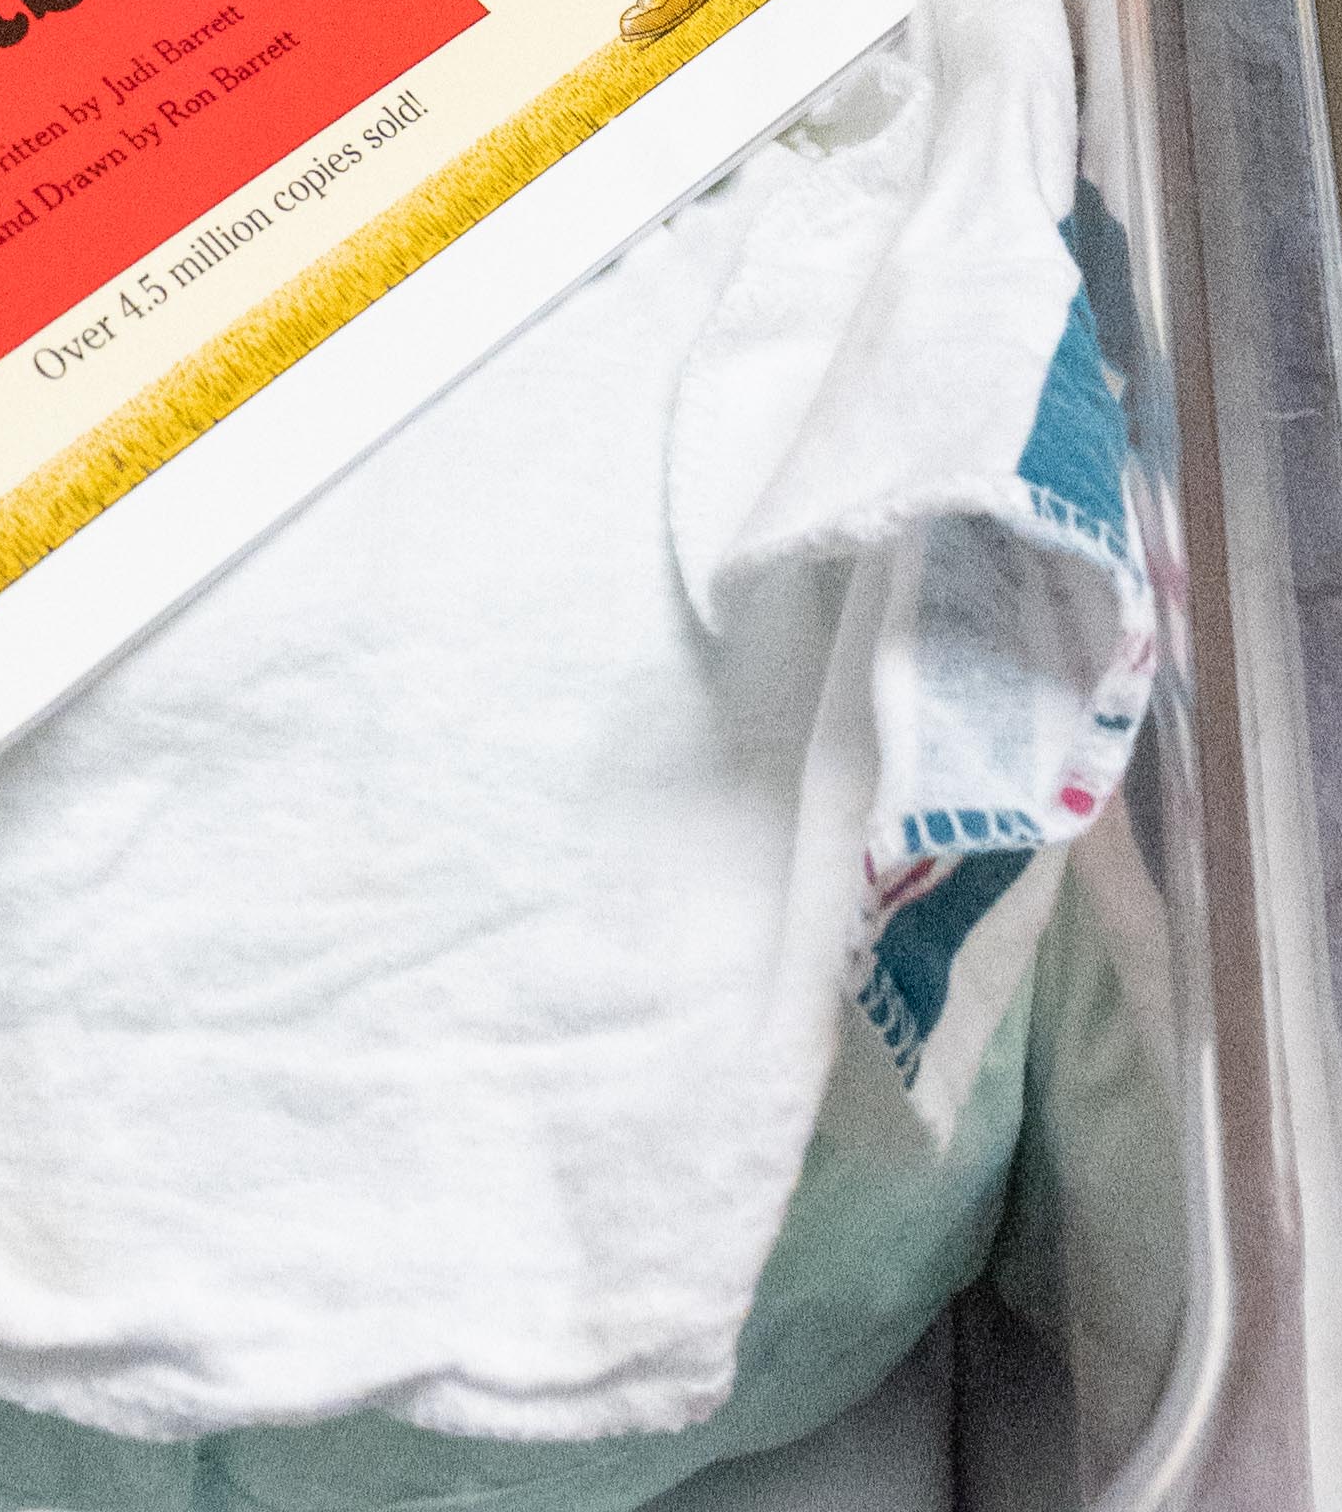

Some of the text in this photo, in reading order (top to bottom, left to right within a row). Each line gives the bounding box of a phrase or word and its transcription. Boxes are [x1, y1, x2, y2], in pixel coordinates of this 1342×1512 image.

[33, 146, 129, 216] Drawn
[125, 120, 164, 159] by
[157, 87, 219, 132] Ron
[209, 30, 301, 94] Barrett
[65, 93, 105, 128] by
[103, 50, 160, 107] Judi
[152, 4, 246, 64] Barrett
[32, 89, 430, 382] Over 4.5 million copies sold!
